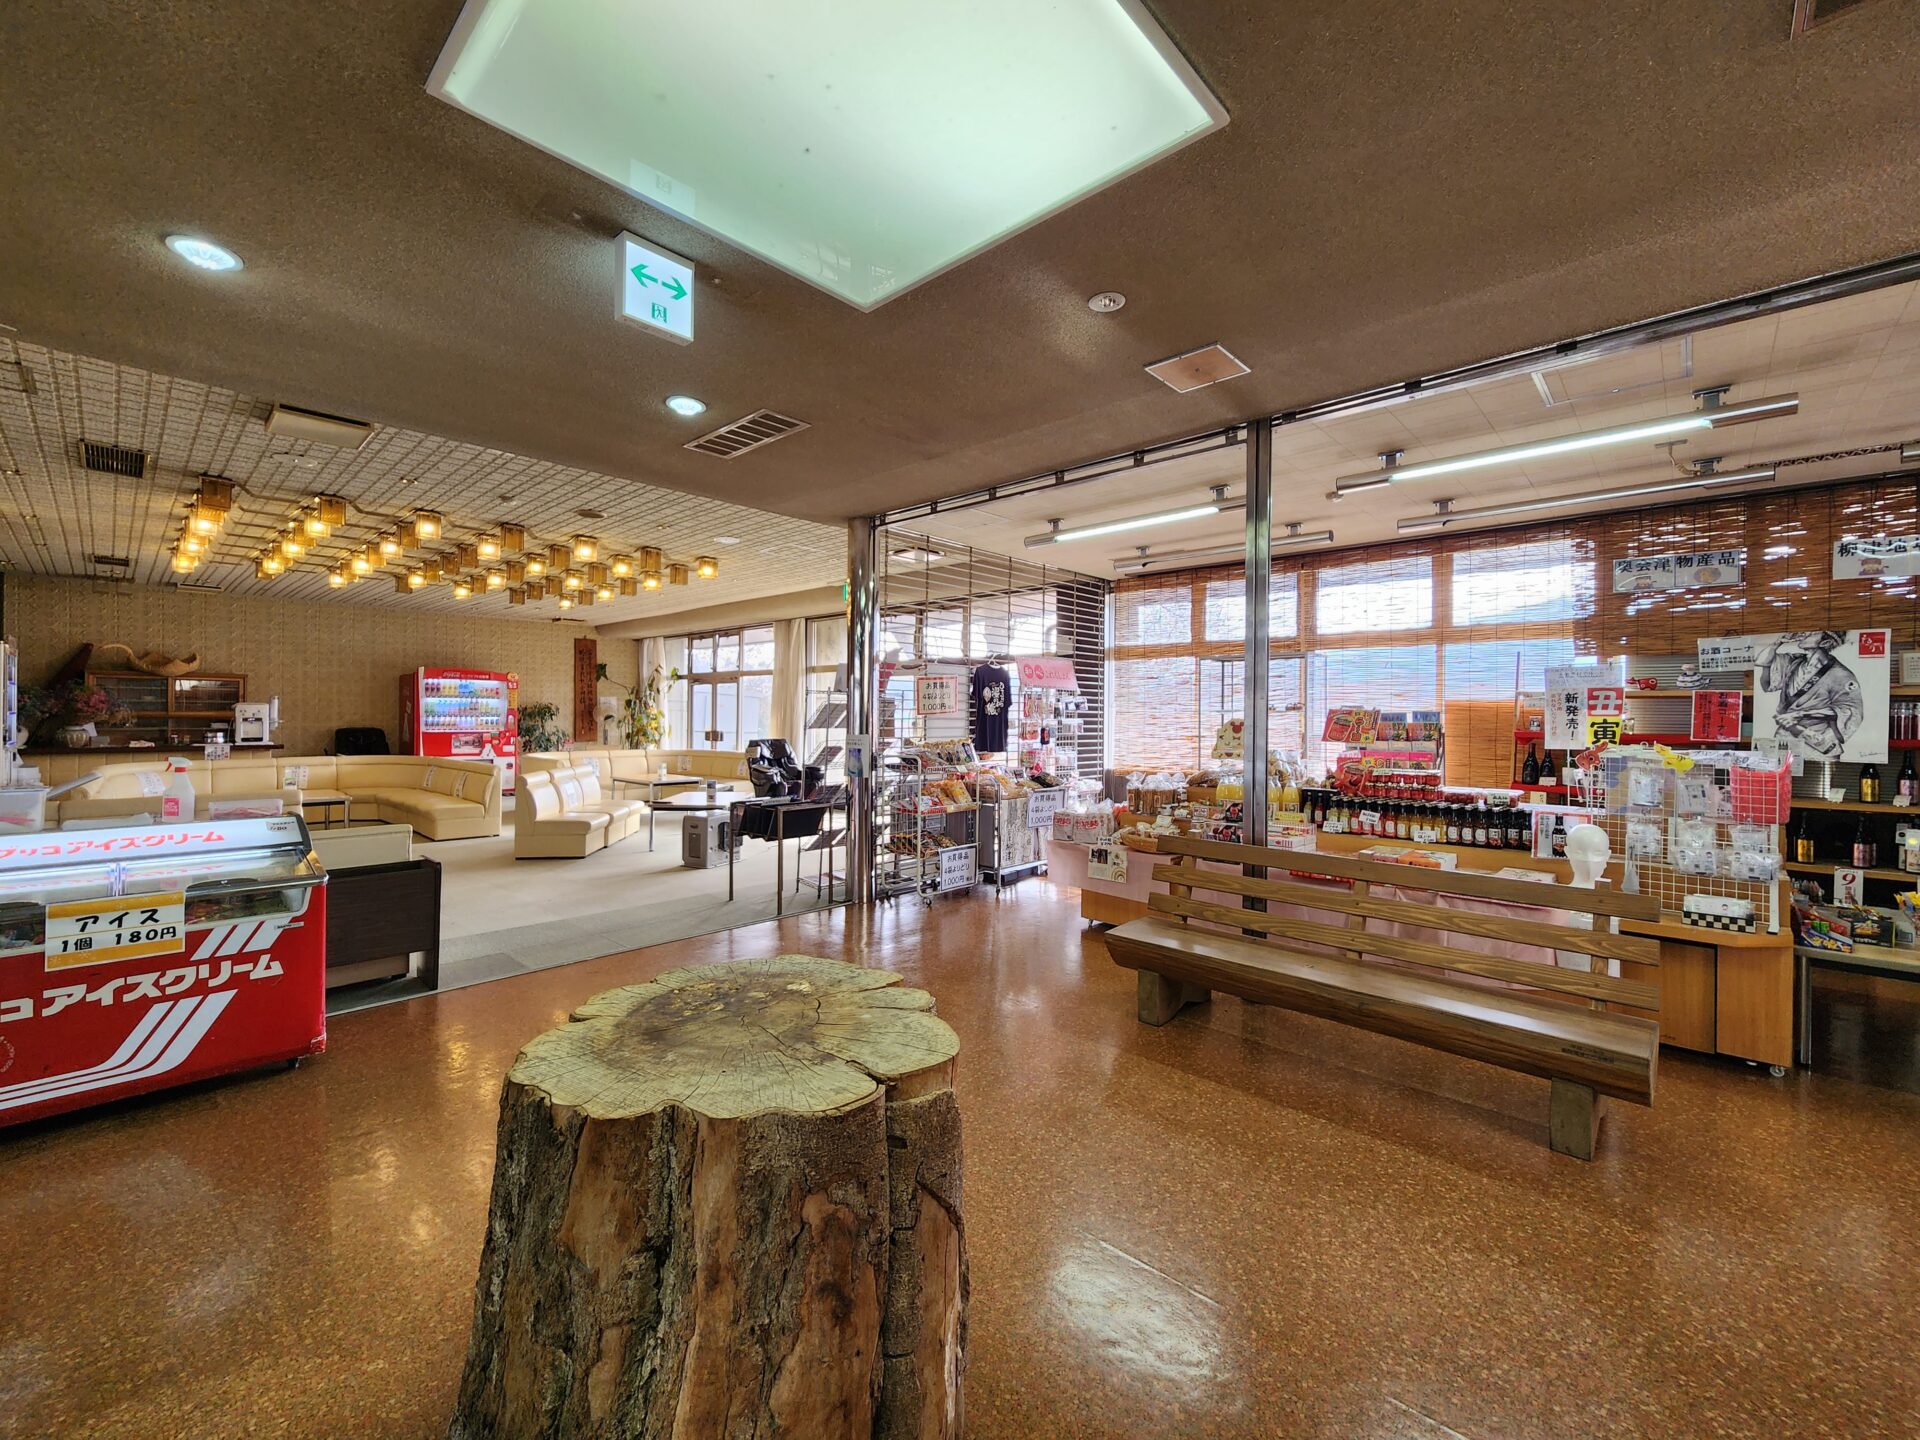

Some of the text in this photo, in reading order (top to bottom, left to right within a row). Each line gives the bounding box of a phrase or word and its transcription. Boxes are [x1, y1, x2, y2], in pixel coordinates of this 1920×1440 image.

[1565, 692, 1579, 740] 新発売！
[1588, 690, 1622, 716] 丑
[1590, 718, 1620, 745] 寅
[75, 908, 160, 933] アイス
[61, 926, 177, 953] 1個 180円
